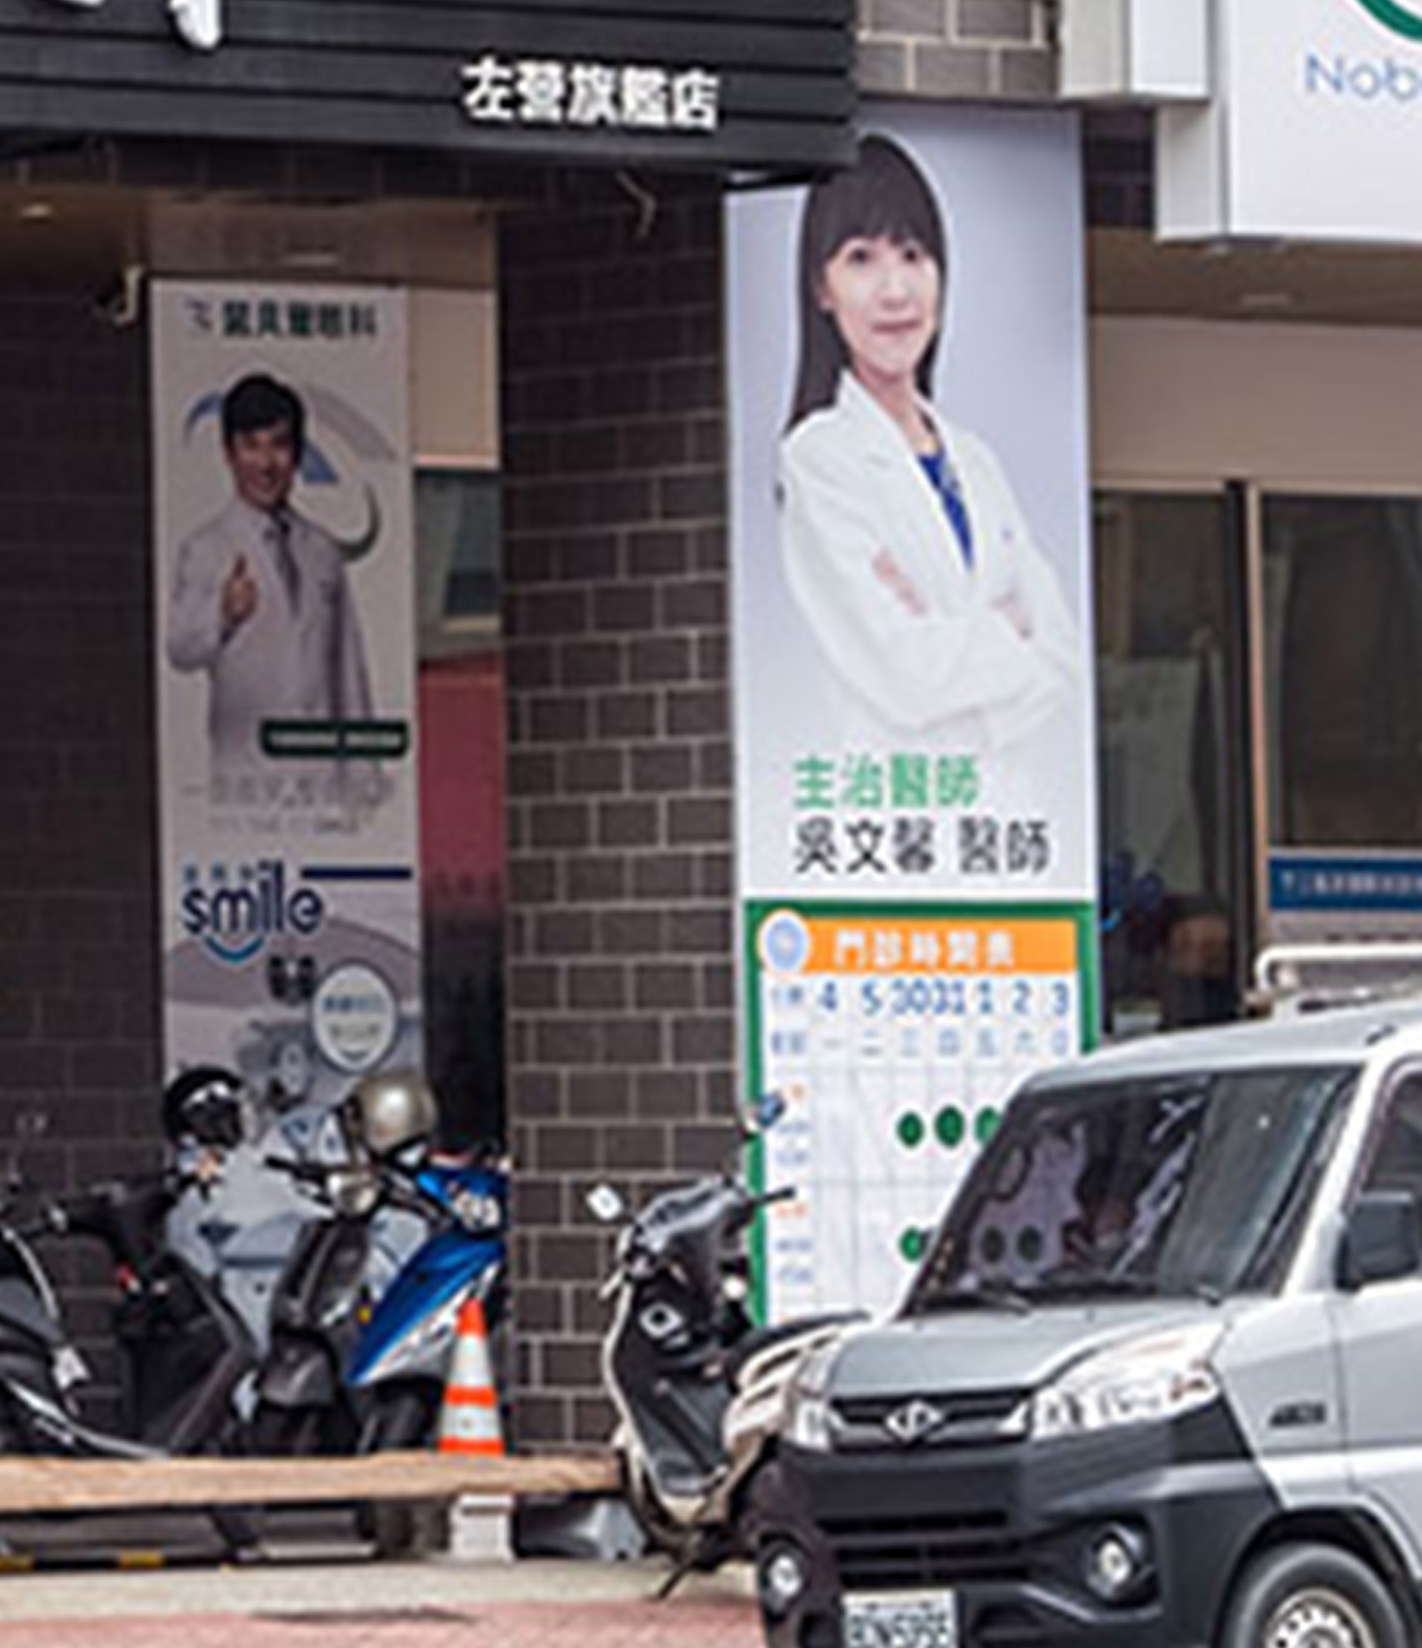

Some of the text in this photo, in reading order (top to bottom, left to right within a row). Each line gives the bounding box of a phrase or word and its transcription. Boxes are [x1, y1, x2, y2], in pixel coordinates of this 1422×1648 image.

[1306, 52, 1422, 100] Nob
[793, 751, 980, 809] 主治醫師
[959, 816, 1051, 875] 醫師
[182, 859, 324, 936] smile
[835, 928, 1015, 970] 門診時間表
[819, 980, 838, 1012] 4
[861, 980, 882, 1016] 5
[1013, 981, 1031, 1014] 2
[1051, 981, 1070, 1016] 3
